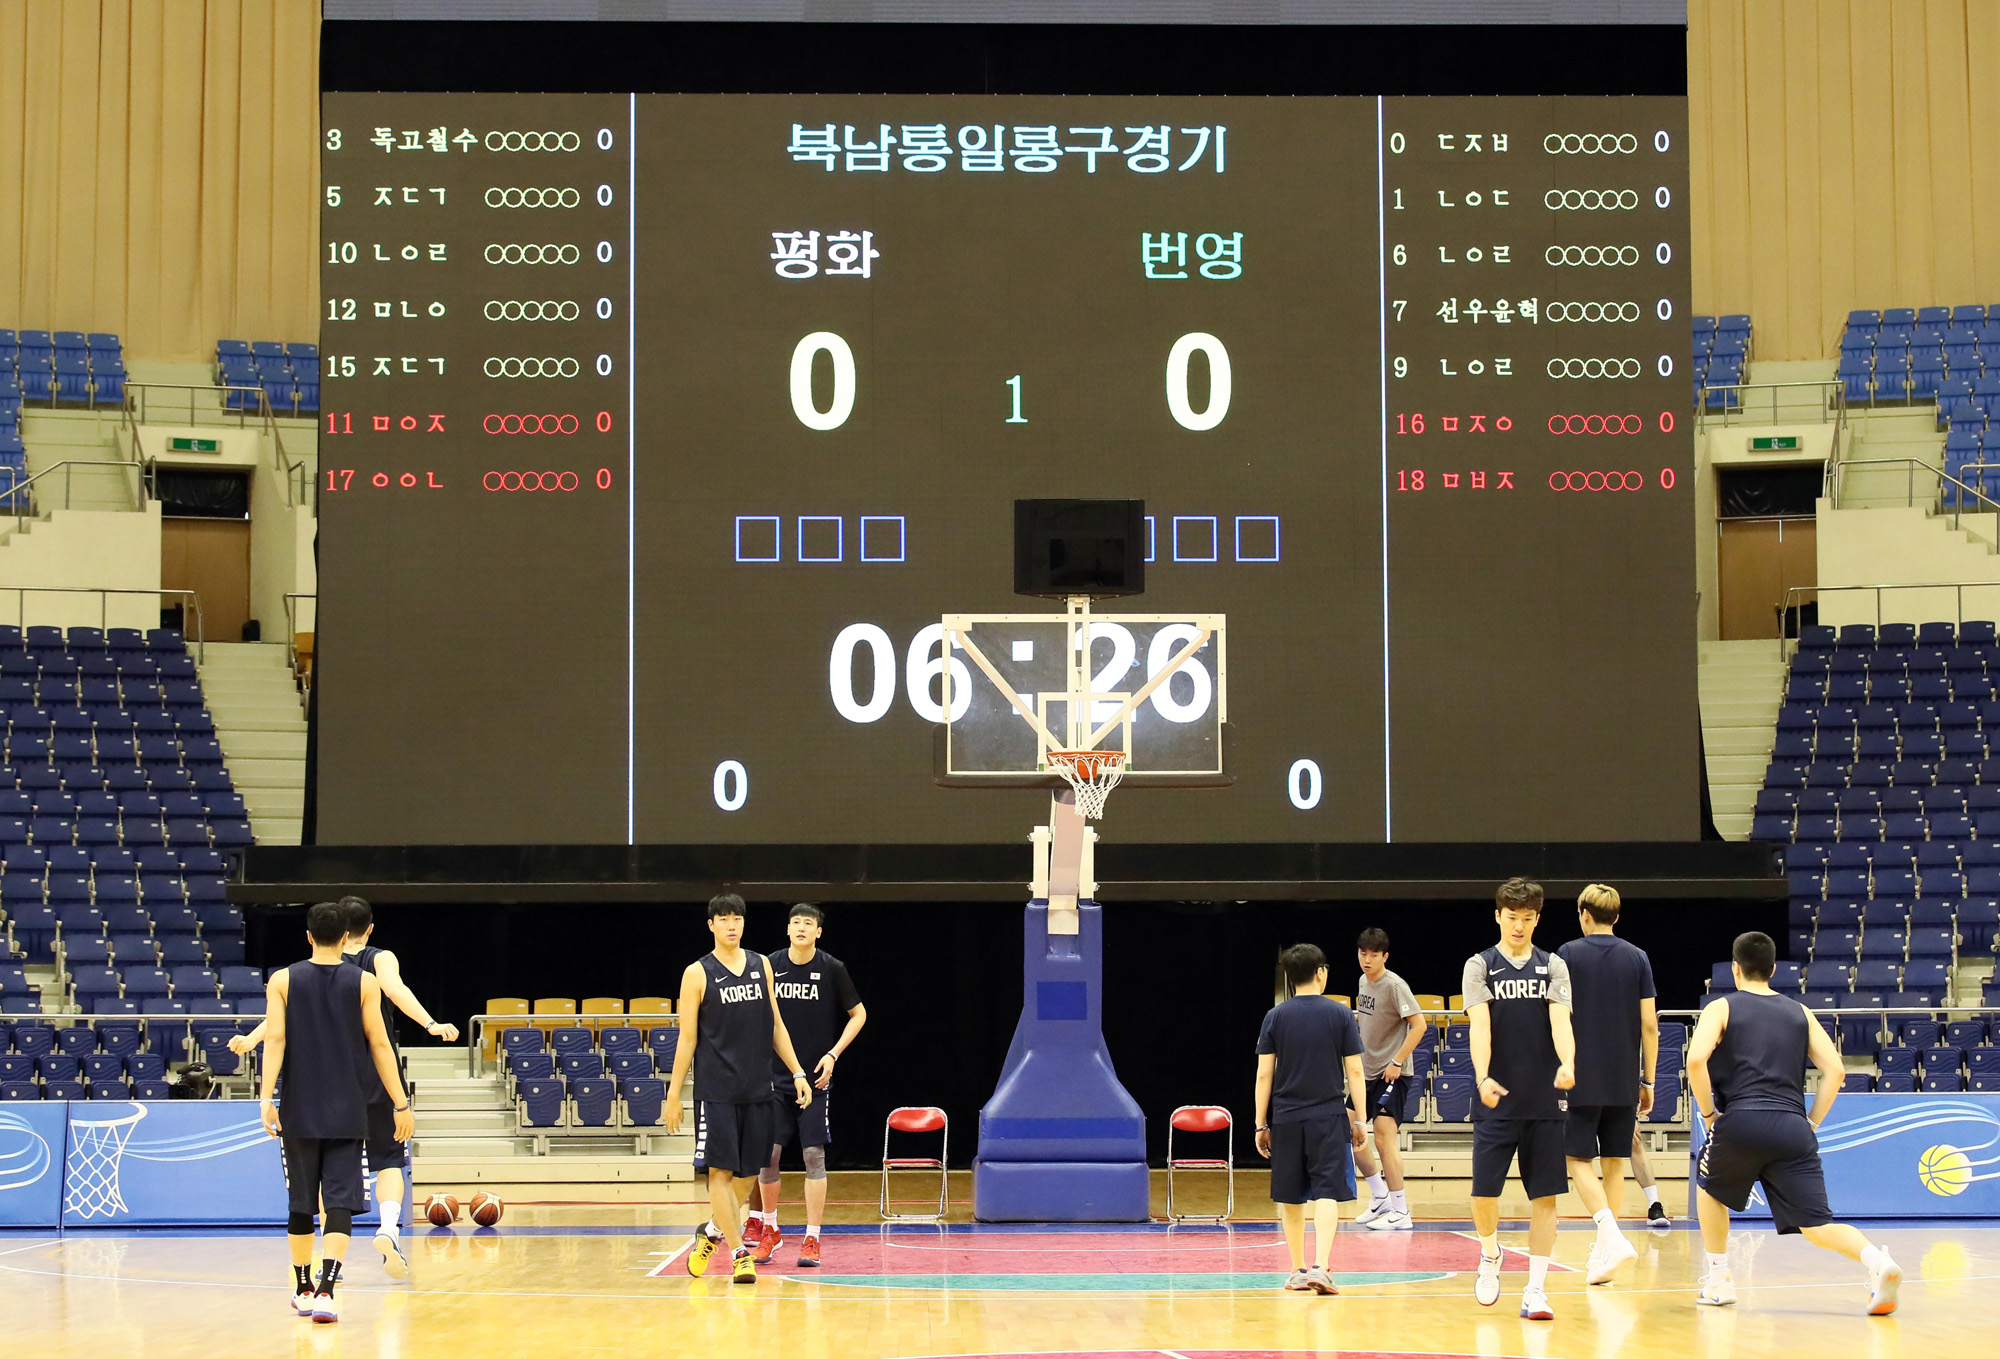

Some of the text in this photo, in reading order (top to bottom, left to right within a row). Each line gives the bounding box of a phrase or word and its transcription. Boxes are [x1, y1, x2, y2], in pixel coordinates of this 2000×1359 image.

[325, 128, 342, 151] 3
[596, 128, 614, 151] 0
[786, 123, 1228, 174] 북남통일롱구경기
[1389, 131, 1406, 154] 0
[1654, 130, 1670, 153] 0
[326, 185, 342, 208] 5
[596, 184, 613, 207] 0
[1393, 187, 1405, 210] 1
[1654, 186, 1671, 209] 0
[327, 241, 358, 264] 10
[596, 240, 613, 263] 0
[770, 230, 881, 279] 평화
[1141, 231, 1244, 280] 번영
[1392, 243, 1408, 266] 6
[1655, 242, 1672, 265] 0
[327, 298, 357, 321] 12
[596, 297, 613, 320] 0
[1392, 300, 1408, 322] 7
[1656, 298, 1673, 321] 0
[327, 355, 356, 378] 15
[595, 353, 613, 377] 0
[1393, 356, 1408, 379] 9
[1657, 354, 1674, 377] 0
[789, 331, 856, 431] 0
[1165, 331, 1232, 432] 0
[1005, 374, 1029, 423] 1
[326, 411, 354, 435] 11
[595, 410, 613, 433] 0
[1396, 412, 1427, 435] 16
[1658, 410, 1676, 434] 0
[325, 468, 356, 492] 17
[594, 467, 613, 490] 0
[1396, 469, 1426, 492] 18
[1659, 467, 1676, 490] 0
[713, 759, 748, 812] 0
[1287, 758, 1323, 810] 0
[719, 982, 763, 1004] KOREA
[775, 982, 819, 1000] KOREA
[1358, 994, 1376, 1010] OREA
[1493, 979, 1548, 1000] KOREA
